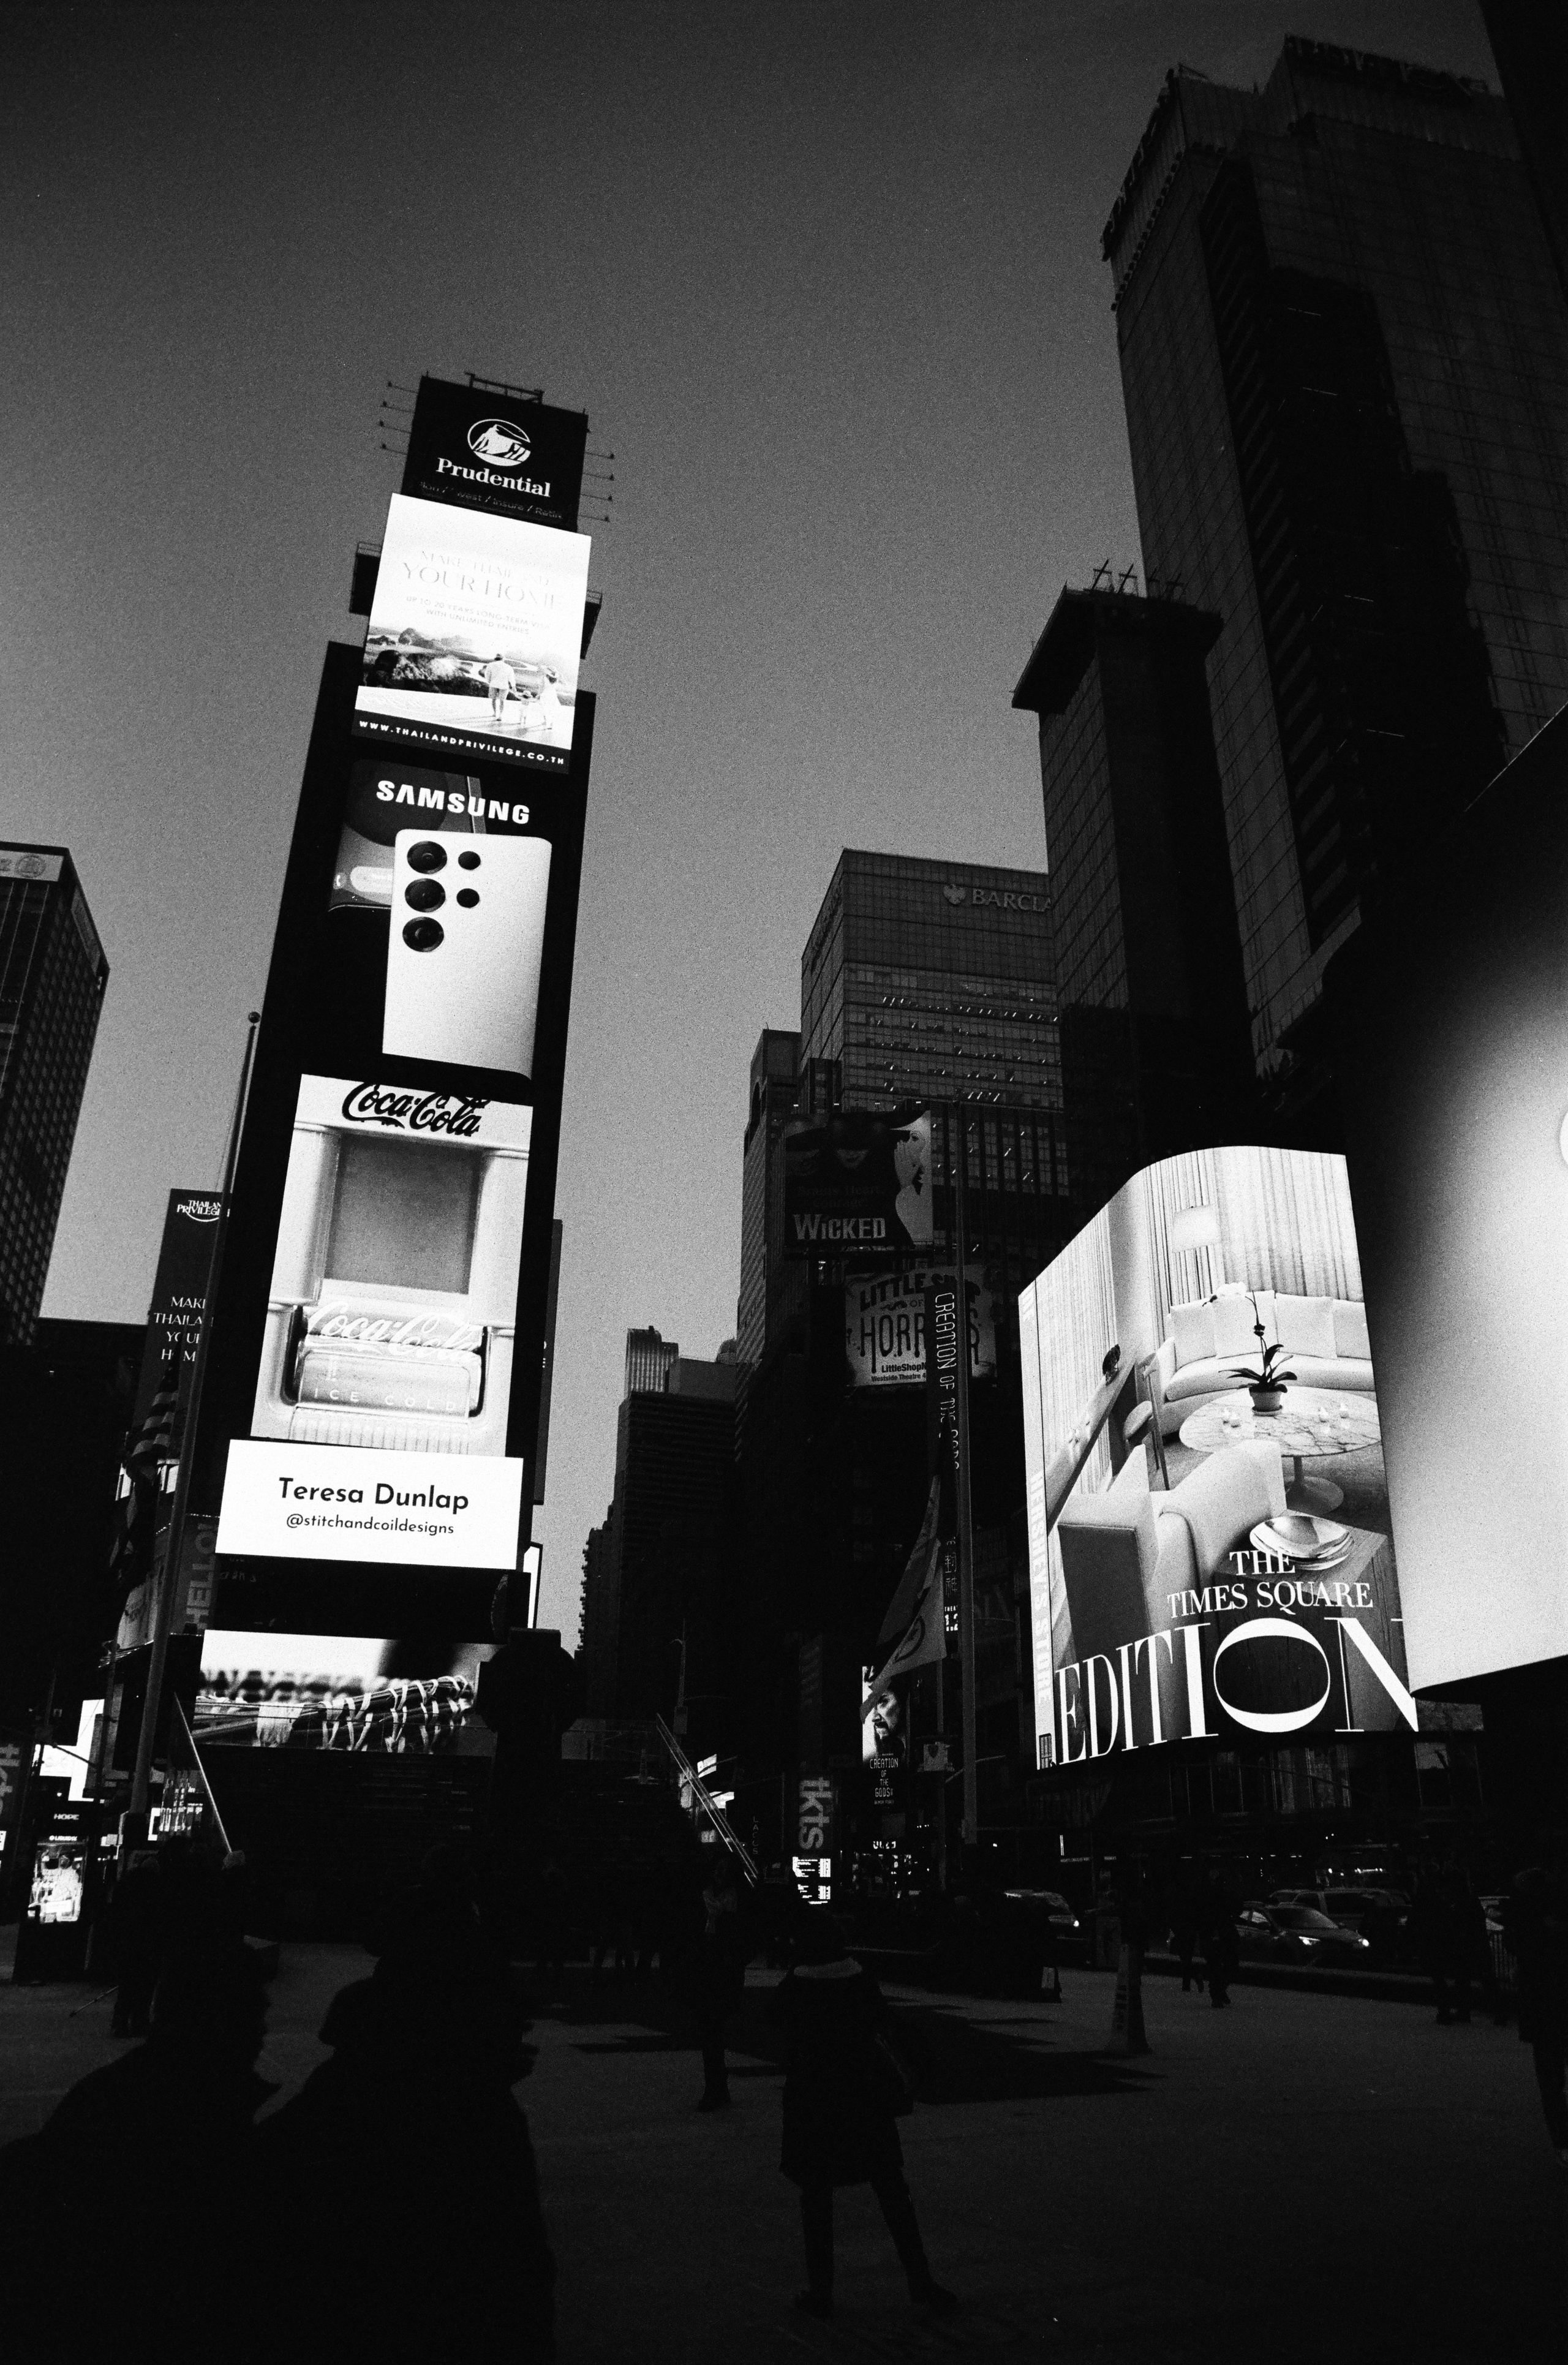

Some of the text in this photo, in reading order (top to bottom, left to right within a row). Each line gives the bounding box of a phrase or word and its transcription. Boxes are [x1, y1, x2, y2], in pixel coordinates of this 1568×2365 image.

[435, 457, 551, 497] Prudential
[402, 562, 475, 592] YOUR
[359, 720, 565, 766] WWW.THAILANDPRIVILEGE.CO.TH
[376, 780, 530, 824] SAMSUNG
[971, 888, 1051, 913] BARCLA
[342, 1082, 491, 1137] Coca-Cola
[176, 1204, 221, 1216] PRIVILEG
[188, 1199, 222, 1210] THAILAN
[154, 1312, 214, 1327] THAILA
[306, 1300, 482, 1359] Coca-Cola
[935, 1292, 957, 1370] CREATION
[314, 1387, 456, 1411] ICE COLD
[939, 1375, 956, 1390] OF
[278, 1477, 469, 1514] Teresa Dunlap
[286, 1514, 455, 1536] @stitchandcoildesigns
[1229, 1548, 1295, 1577] THE
[1167, 1581, 1374, 1619] TIMES SQUARE
[1055, 1616, 1419, 1766] EDITION
[799, 1777, 833, 1850] tkts
